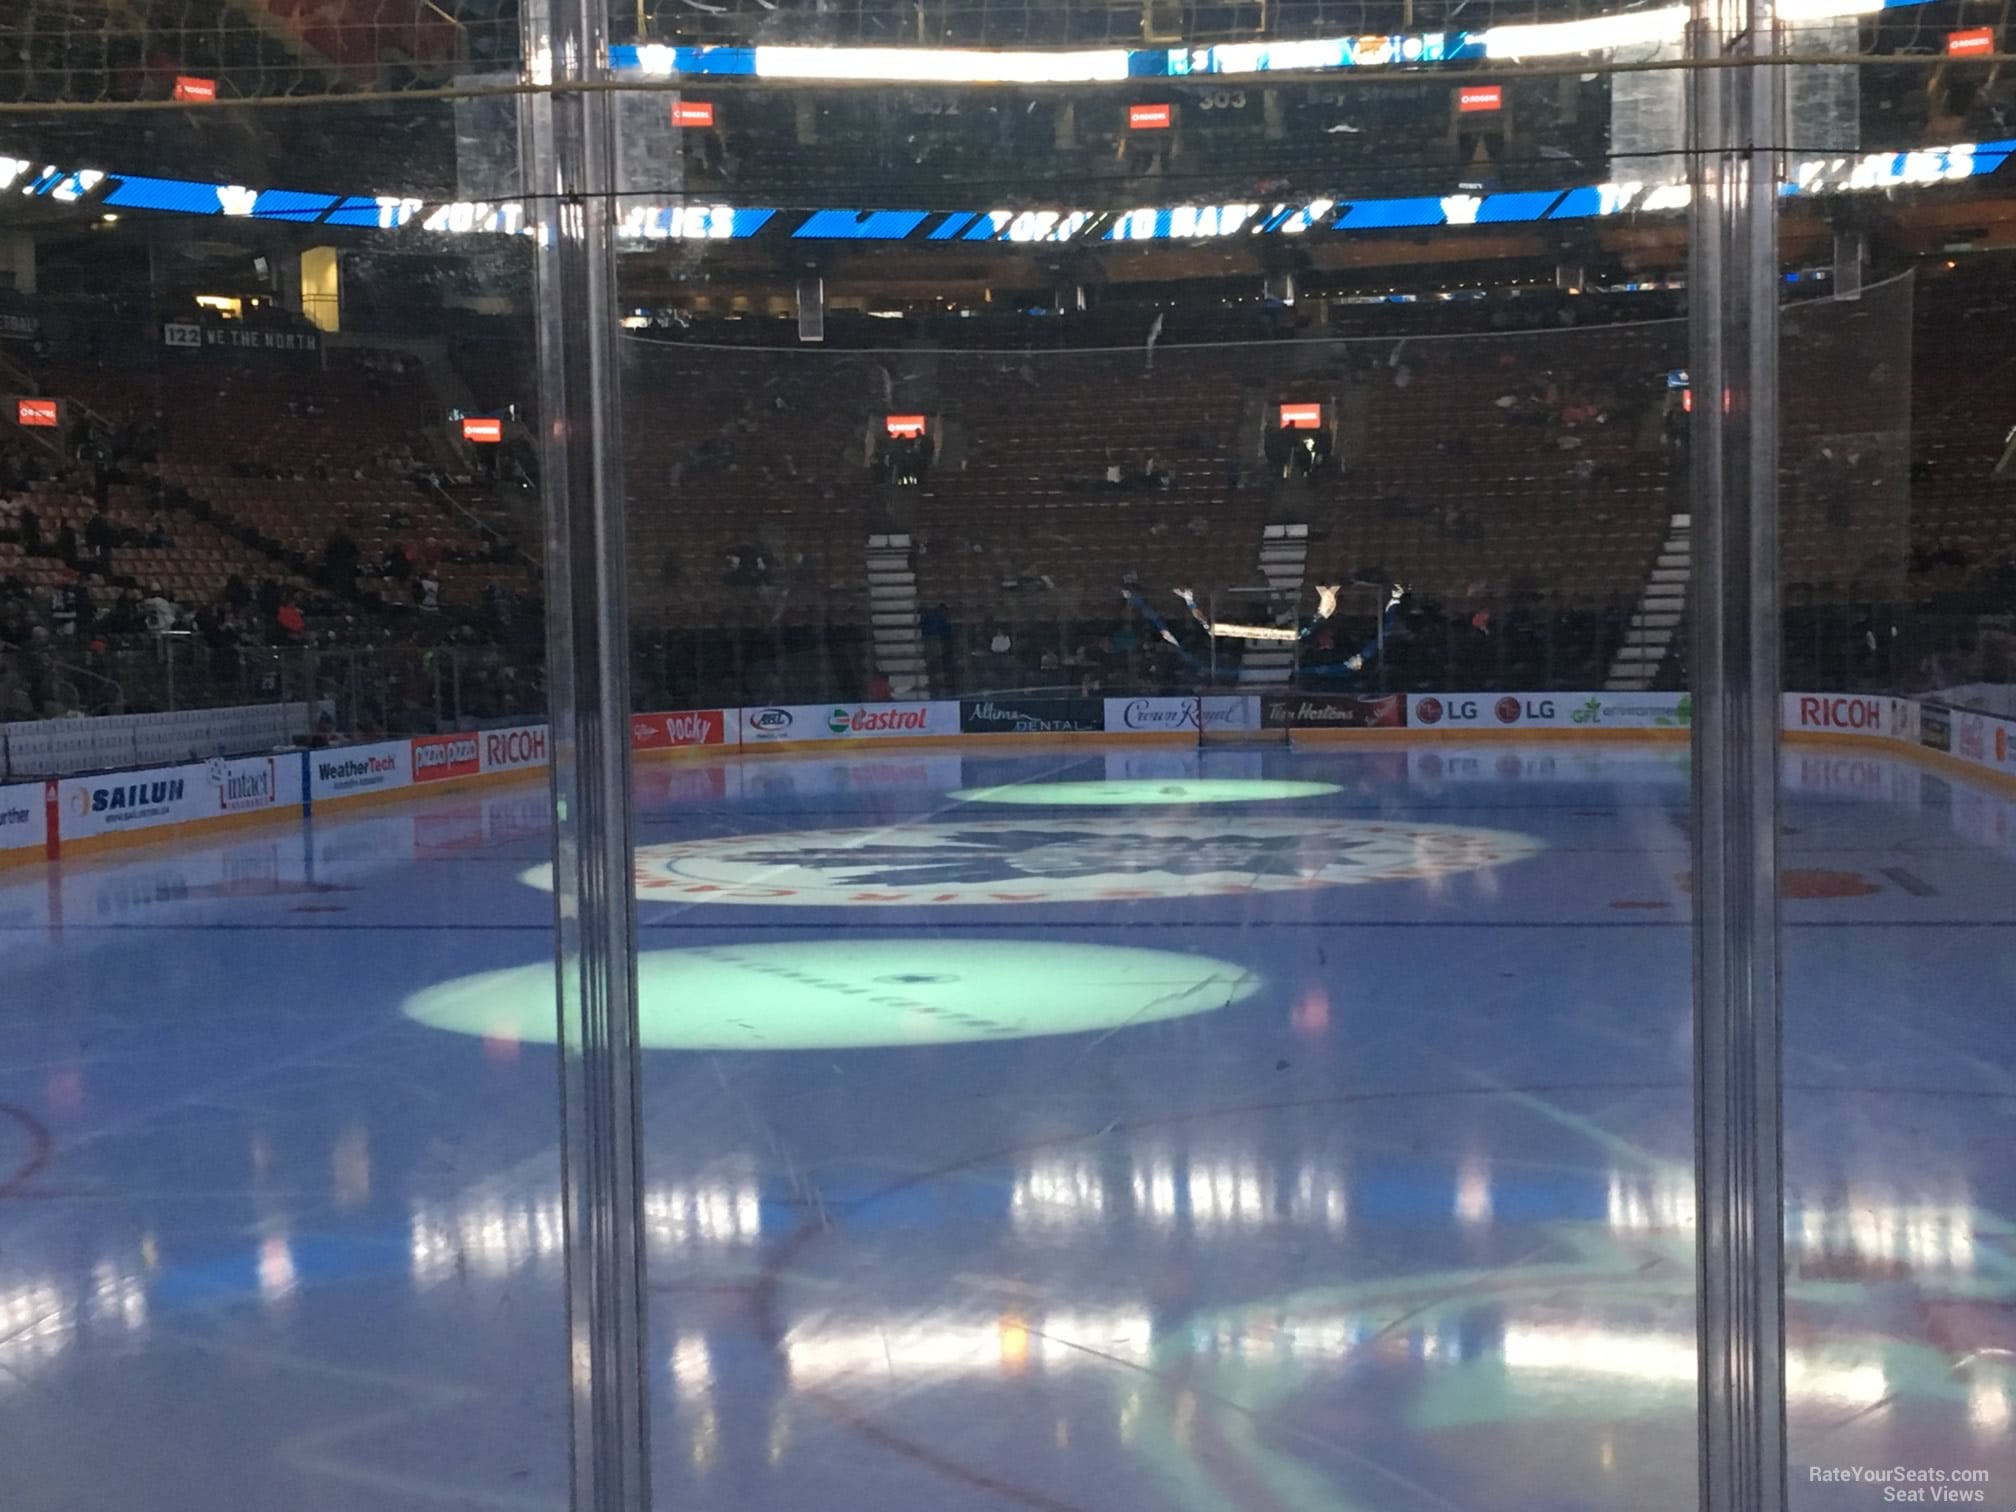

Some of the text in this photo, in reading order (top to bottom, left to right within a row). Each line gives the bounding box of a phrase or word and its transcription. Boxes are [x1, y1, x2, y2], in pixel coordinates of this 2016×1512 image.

[1200, 90, 1246, 110] 303
[168, 327, 200, 344] 122
[230, 330, 259, 347] THE
[265, 332, 317, 350] NORTH
[851, 707, 928, 732] Castrol
[1124, 699, 1178, 729] Crown
[1269, 701, 1354, 721] Tim Hortons
[1448, 701, 1478, 720] LG
[1527, 700, 1555, 719] LG
[1801, 697, 1881, 730] RICOH
[1013, 720, 1080, 732] DENTAL
[487, 730, 545, 766] RICOH
[319, 754, 396, 781] WeatherTech
[92, 778, 184, 812] SAILUN
[228, 770, 268, 800] intact
